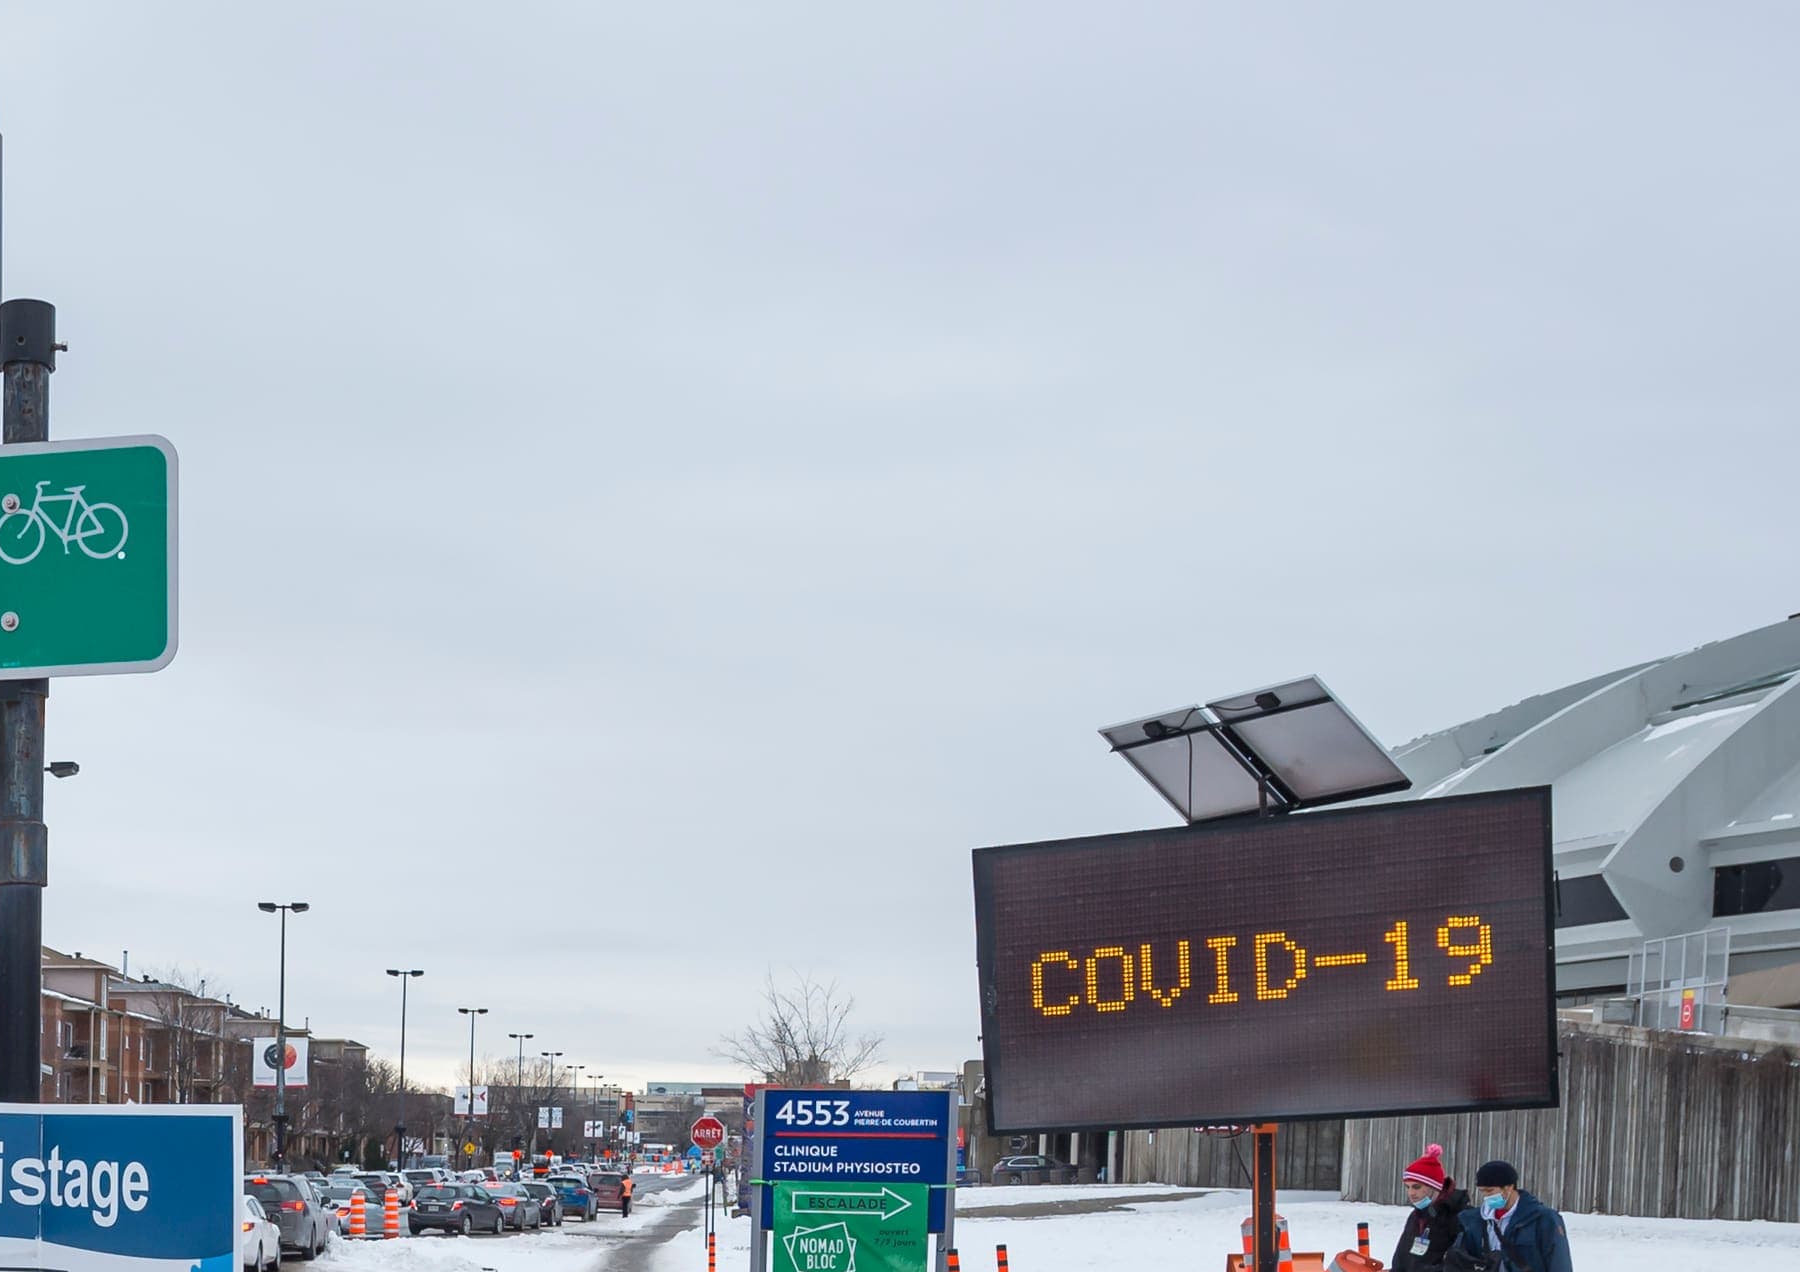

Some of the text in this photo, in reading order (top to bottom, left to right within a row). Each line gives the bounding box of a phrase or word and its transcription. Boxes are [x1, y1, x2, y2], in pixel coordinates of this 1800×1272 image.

[1031, 915, 1493, 1017] COVID-19
[775, 1099, 850, 1127] 4553
[854, 1110, 885, 1118] AVENUE
[893, 1118, 938, 1127] COUBERTIN
[693, 1126, 721, 1138] ARRÊT
[774, 1145, 838, 1158] CLINIQUE
[773, 1161, 921, 1175] STADIUM PHYSIOSTEO
[808, 1197, 888, 1210] ESCALADE
[799, 1238, 844, 1255] NOMAD
[806, 1254, 837, 1270] BLOC
